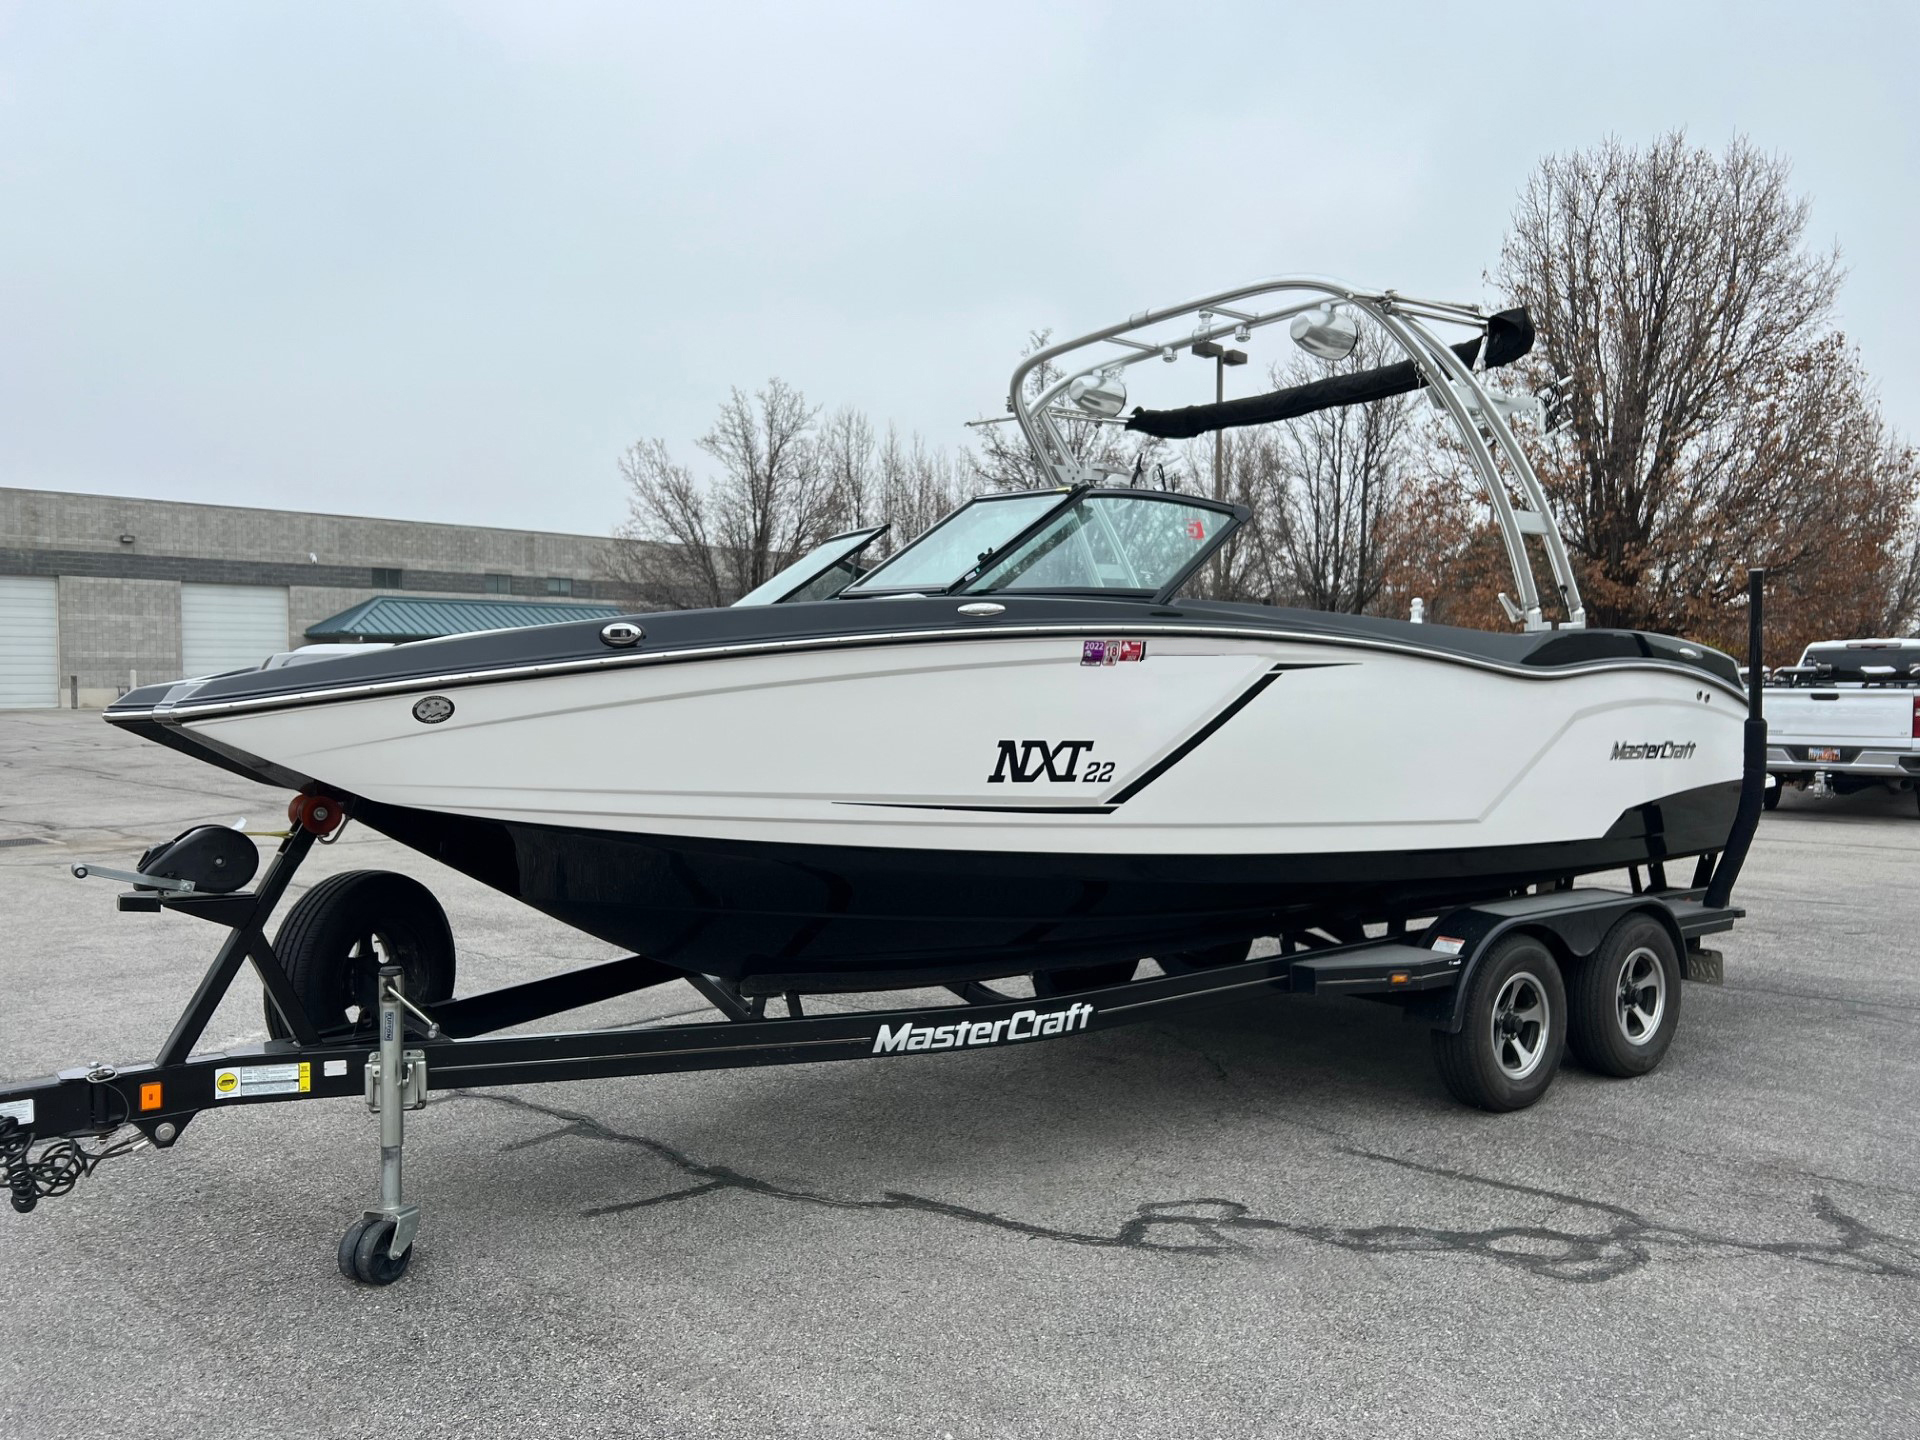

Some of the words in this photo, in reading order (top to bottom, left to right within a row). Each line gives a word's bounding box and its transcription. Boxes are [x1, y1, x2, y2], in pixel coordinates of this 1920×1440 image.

[1085, 642, 1104, 650] 2022
[1107, 646, 1118, 657] 18
[1609, 740, 1697, 760] MasterCraft
[987, 740, 1094, 783] NXT
[1082, 762, 1116, 783] 22
[872, 1002, 1094, 1053] MasterCraft
